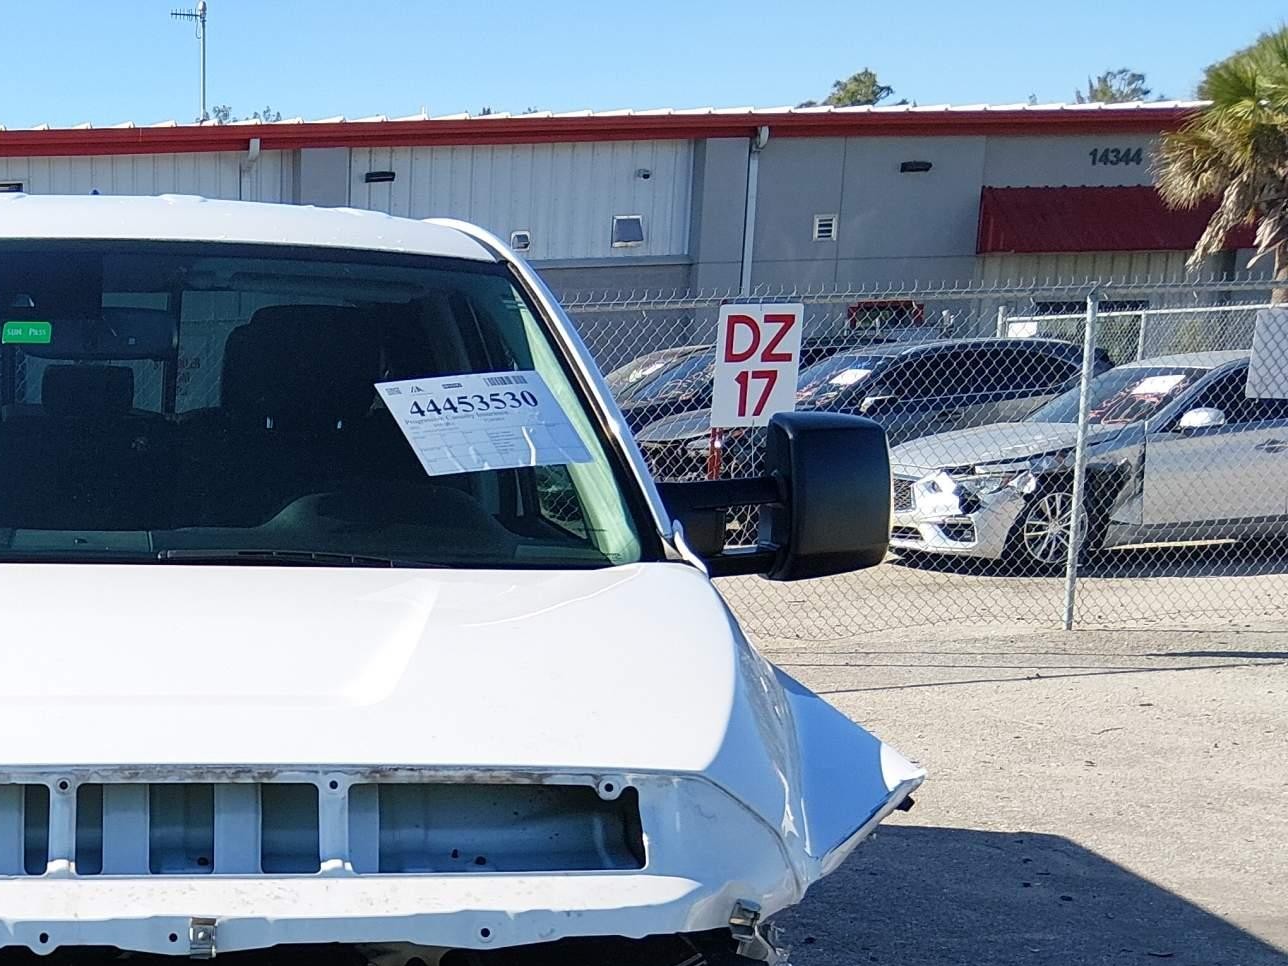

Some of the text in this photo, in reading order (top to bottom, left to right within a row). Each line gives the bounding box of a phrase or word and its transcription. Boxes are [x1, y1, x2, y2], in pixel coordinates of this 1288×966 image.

[1089, 147, 1142, 166] 14344
[724, 314, 796, 363] DZ
[409, 390, 539, 417] 44453530
[734, 370, 778, 417] 17
